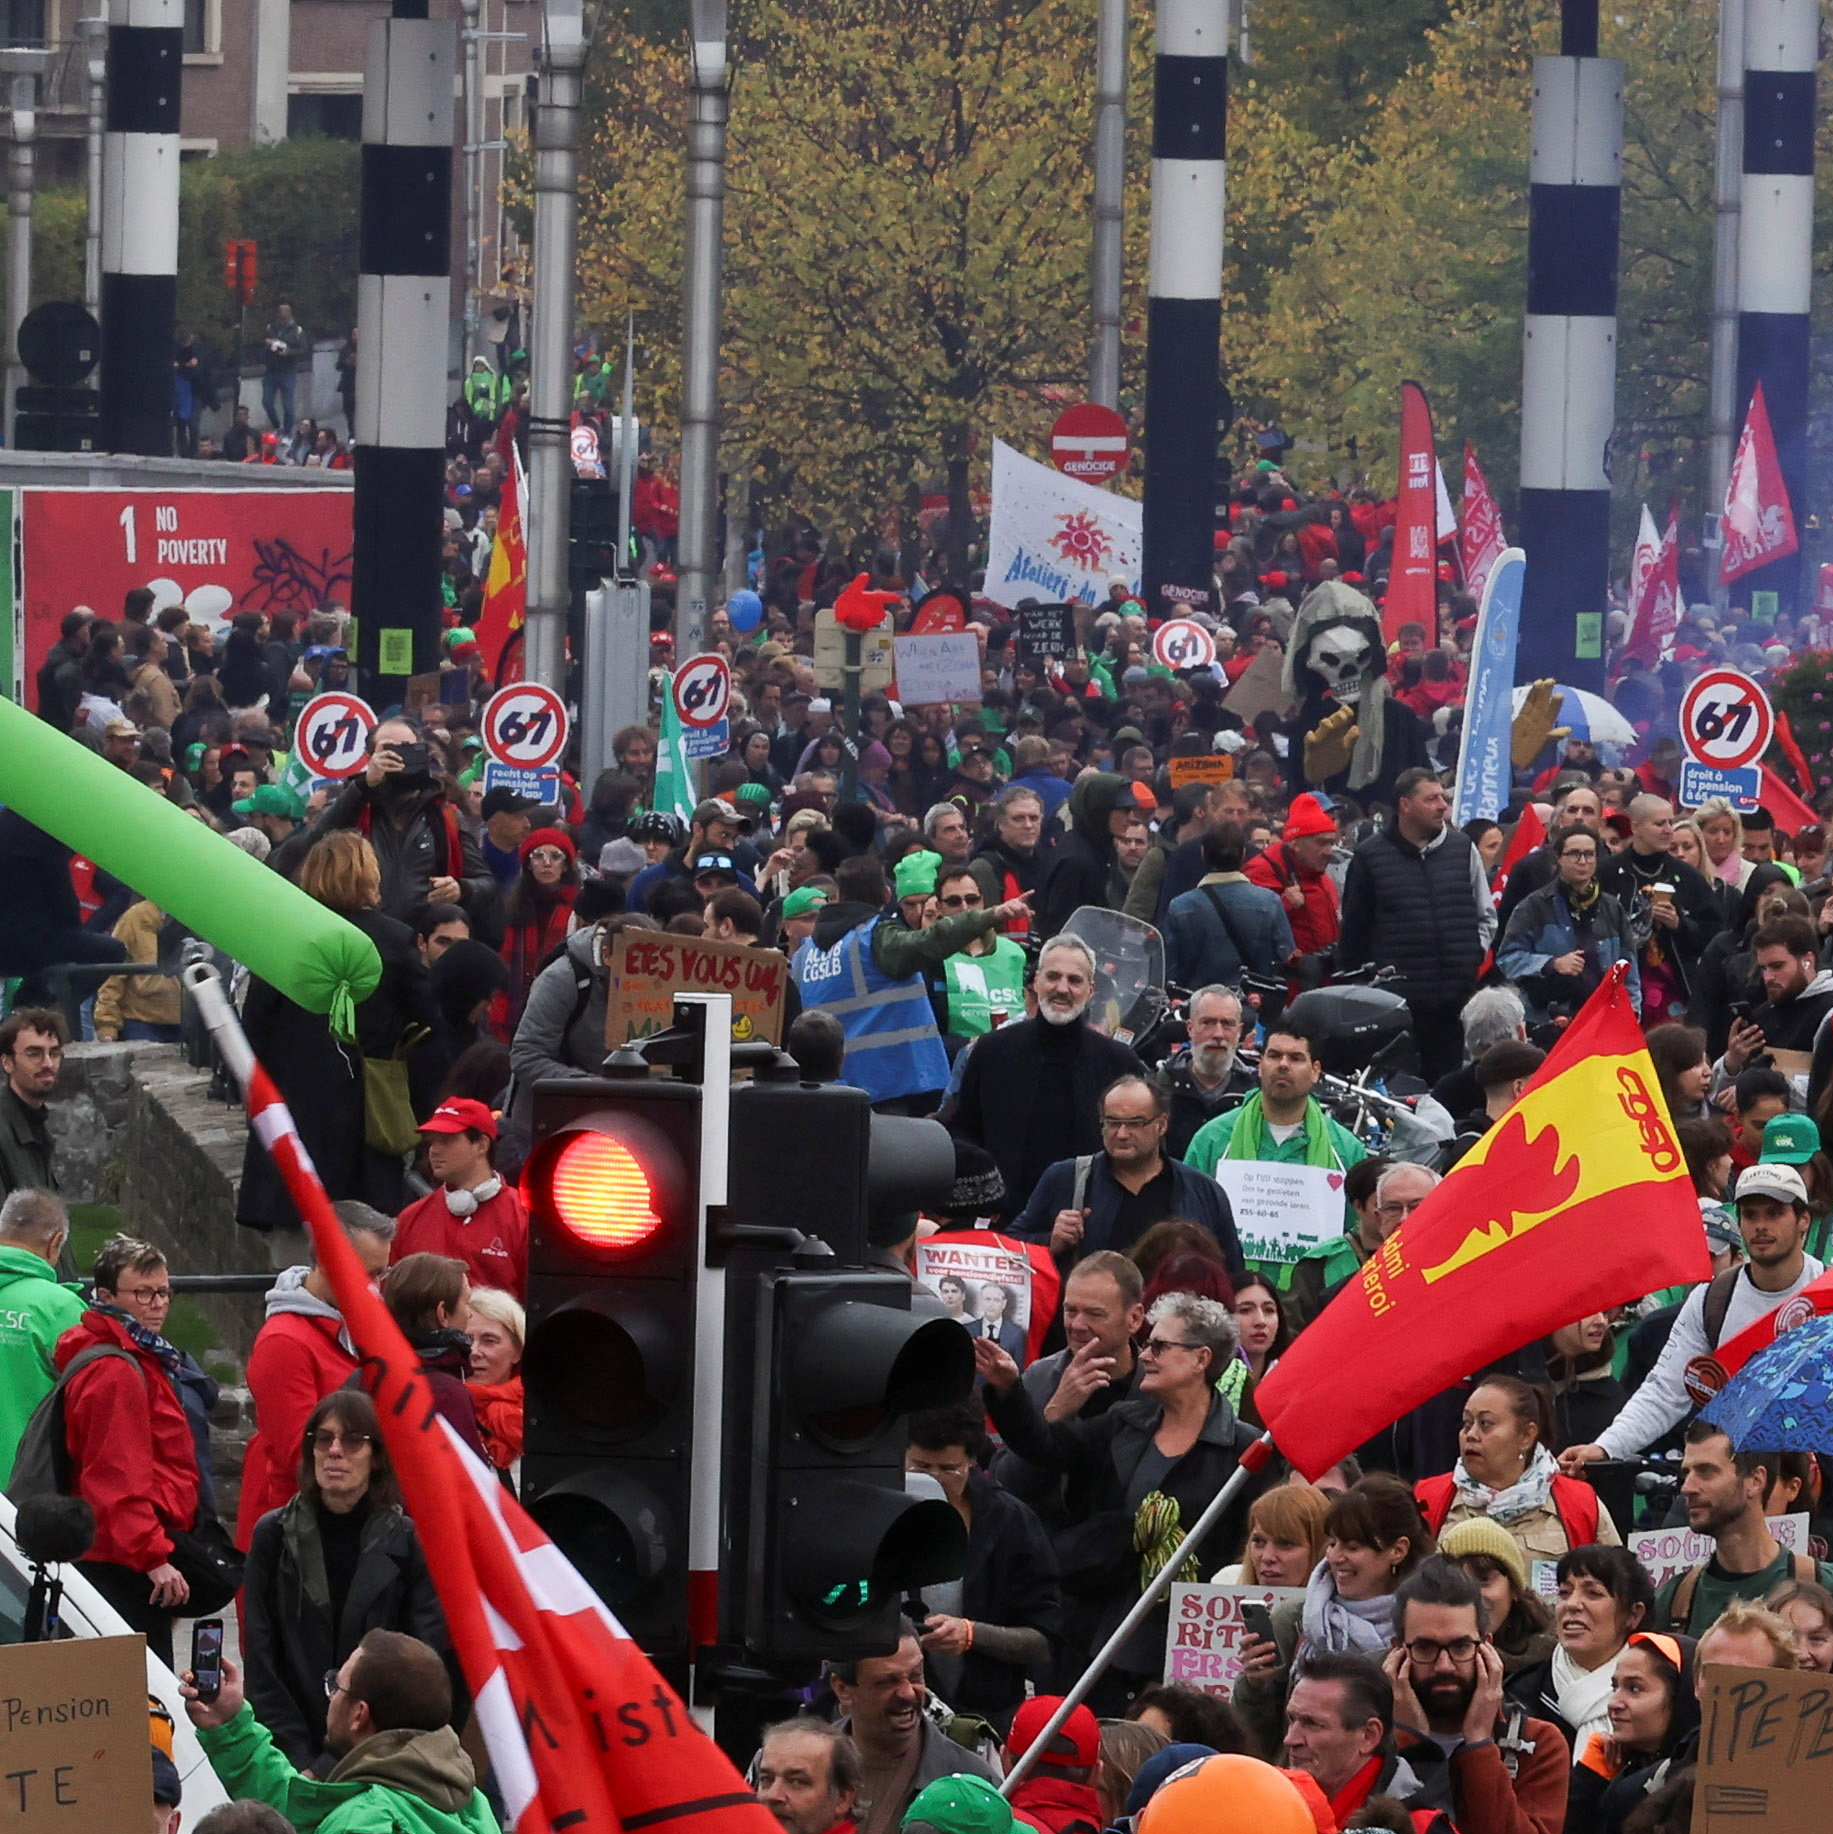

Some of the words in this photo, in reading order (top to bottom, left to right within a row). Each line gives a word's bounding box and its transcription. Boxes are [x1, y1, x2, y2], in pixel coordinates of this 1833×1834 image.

[1064, 462, 1116, 472] GENOCIDE
[155, 506, 179, 533] NO
[119, 505, 137, 563] 1
[157, 537, 227, 565] POVERTY
[1168, 635, 1198, 659] 67
[683, 679, 723, 709] 67
[311, 714, 355, 757] 67
[497, 711, 551, 746] 67
[1694, 701, 1752, 744] 67
[491, 769, 518, 780] recht
[523, 771, 537, 781] op
[1687, 768, 1713, 781] droit
[1715, 769, 1723, 781] à
[1687, 780, 1696, 789] la
[1699, 782, 1743, 795] pension
[1686, 790, 1693, 800] à
[680, 948, 741, 988] VOUS
[802, 958, 842, 983] CGSLB
[1383, 1230, 1411, 1280] Admi
[928, 1267, 949, 1276] voor
[3, 1697, 111, 1733] Pension
